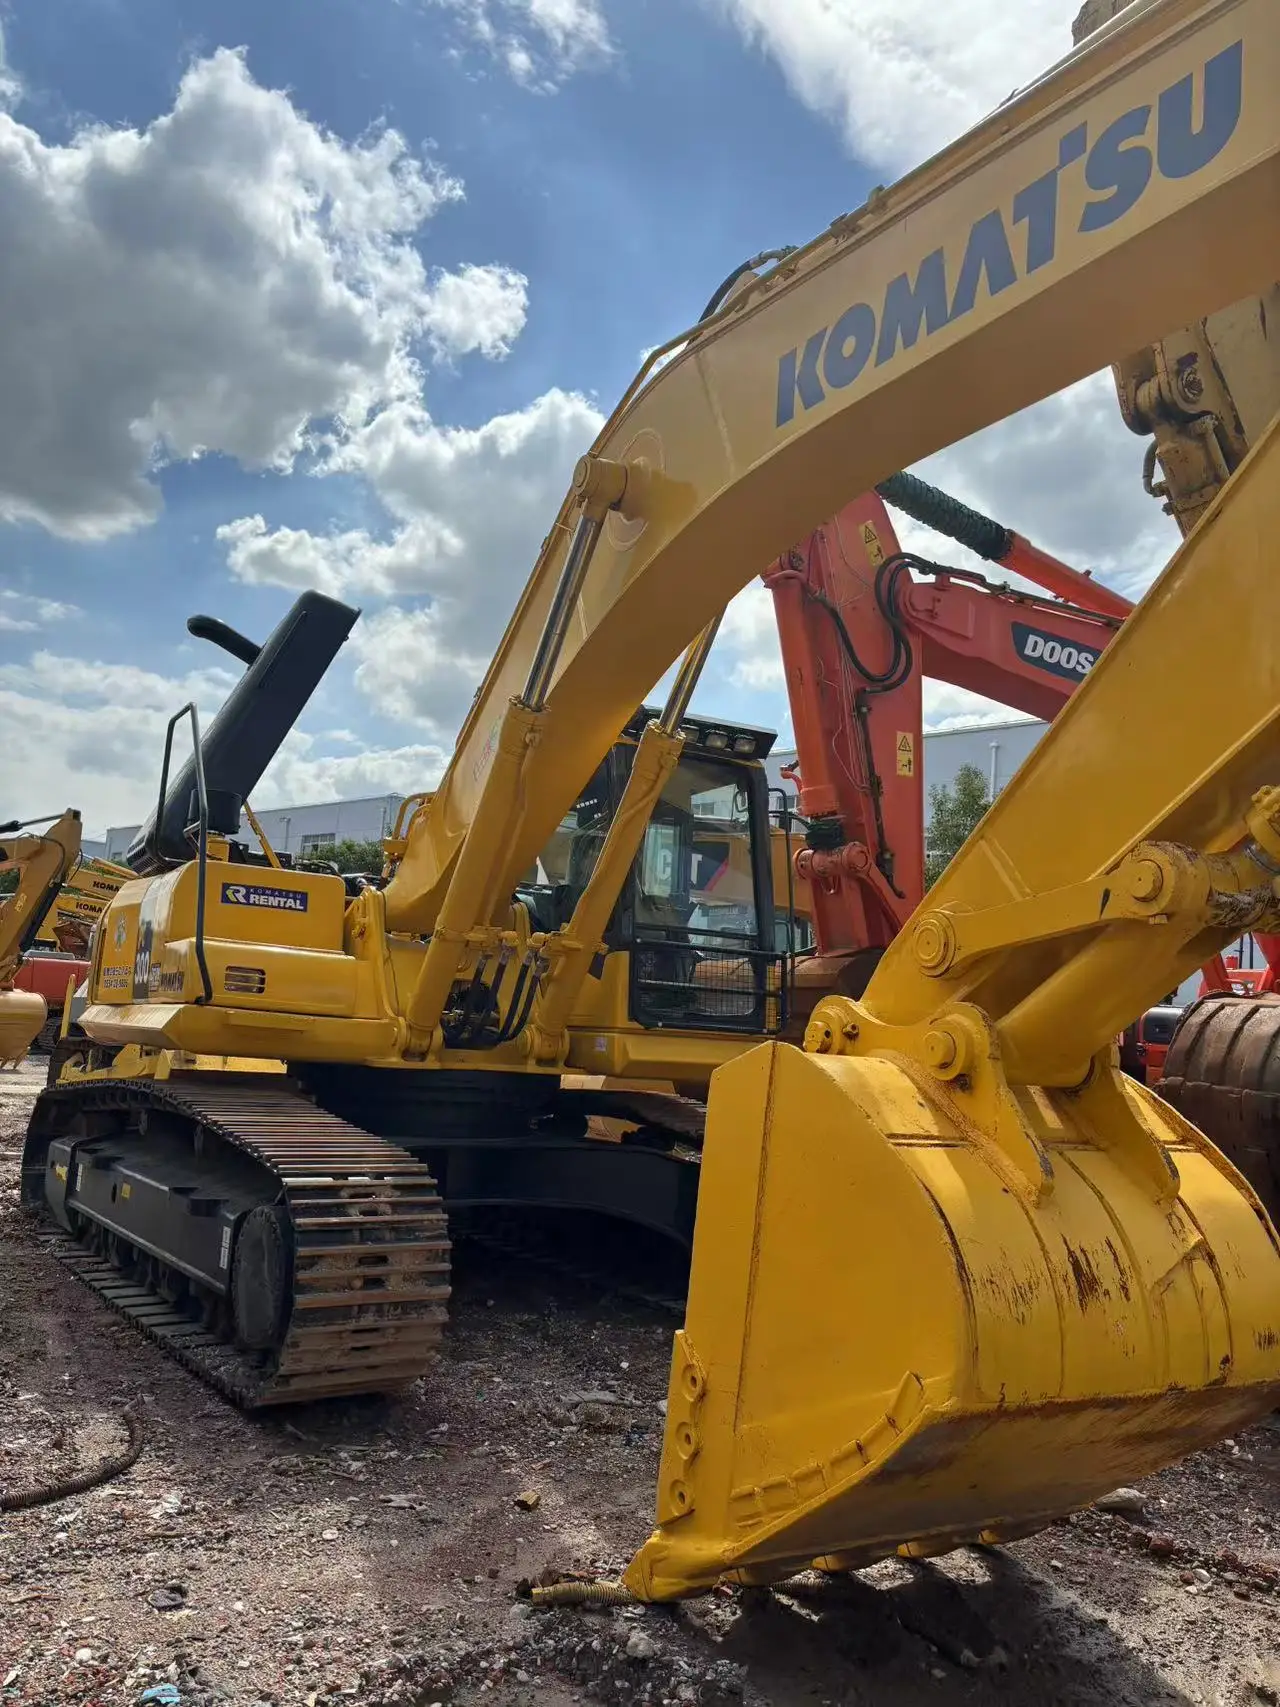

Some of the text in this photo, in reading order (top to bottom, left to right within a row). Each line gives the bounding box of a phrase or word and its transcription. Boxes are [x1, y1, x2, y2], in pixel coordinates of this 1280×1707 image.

[775, 38, 1243, 428] KOMATSU
[1024, 633, 1094, 674] DOOS
[249, 887, 302, 899] KOMATSU
[249, 893, 305, 910] RENTAL
